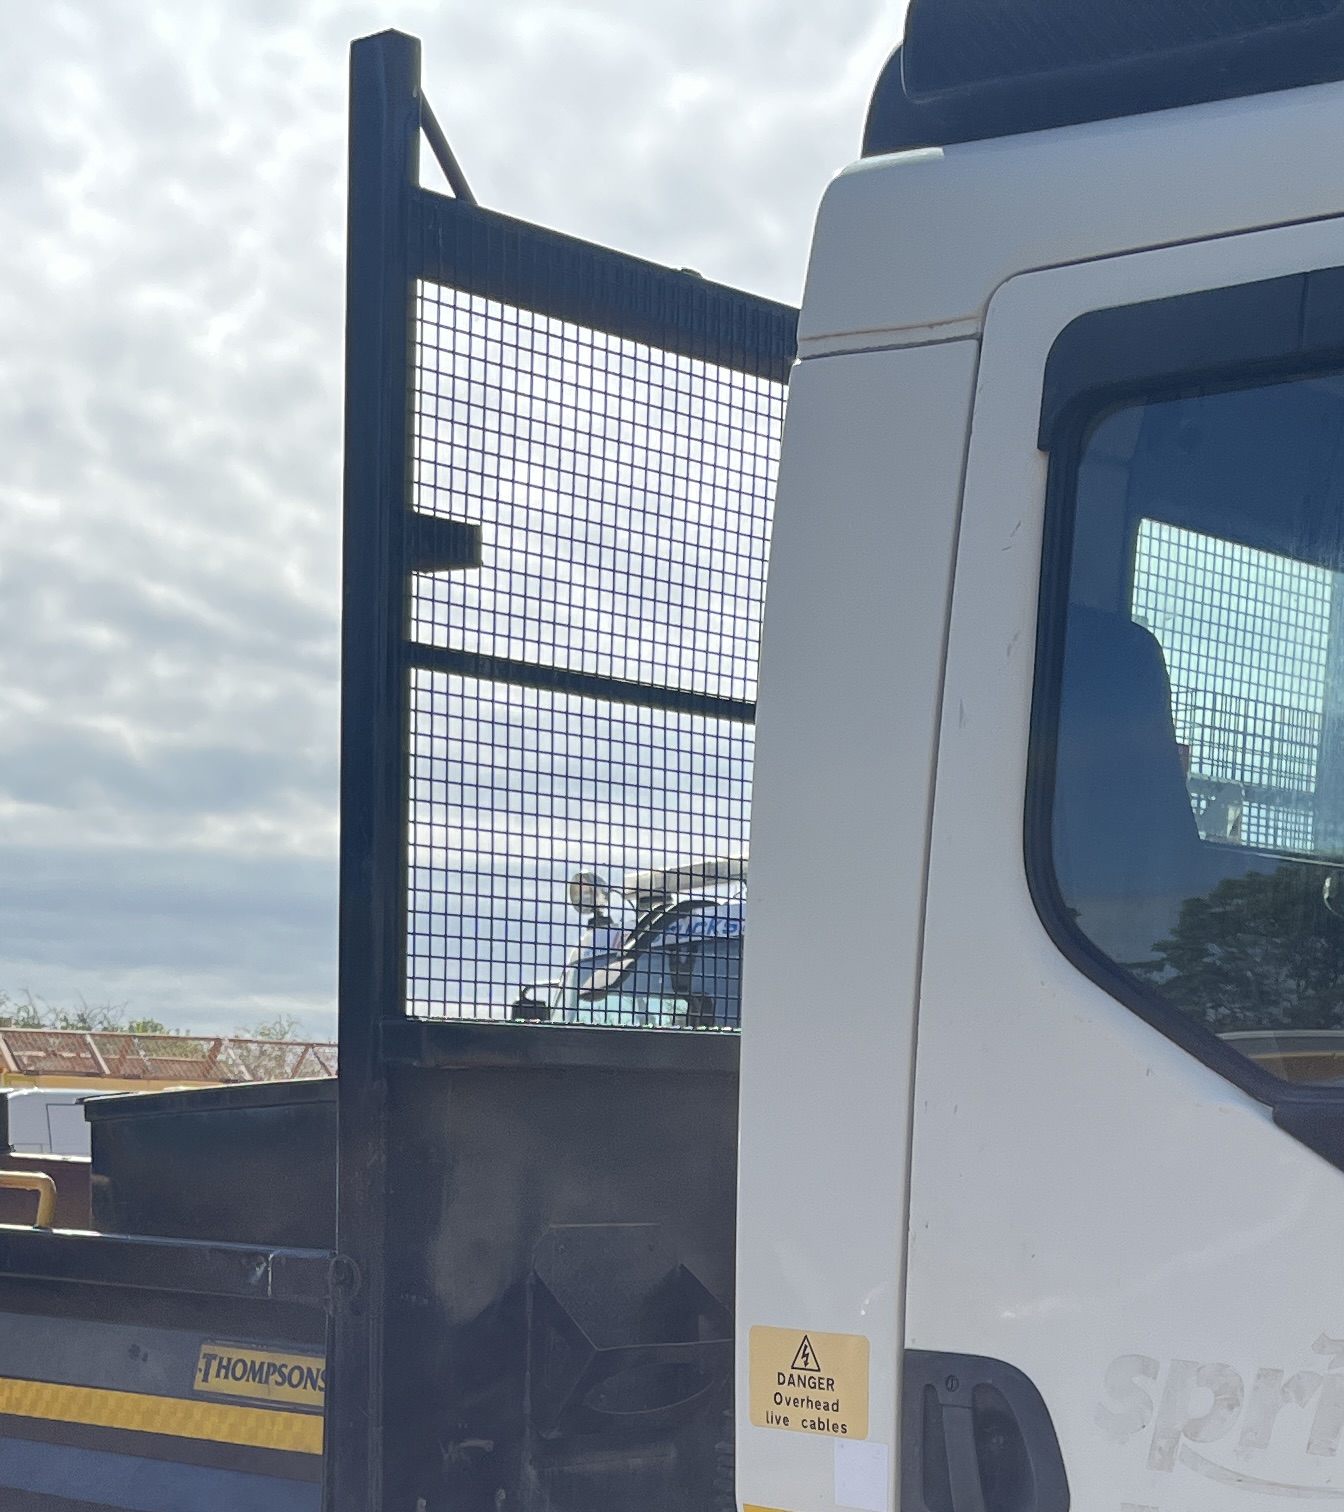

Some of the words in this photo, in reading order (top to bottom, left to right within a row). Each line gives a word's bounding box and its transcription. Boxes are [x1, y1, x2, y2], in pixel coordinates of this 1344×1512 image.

[776, 1371, 835, 1392] DANGER
[773, 1391, 840, 1413] Overhead
[765, 1410, 791, 1427] live
[800, 1416, 849, 1435] cables
